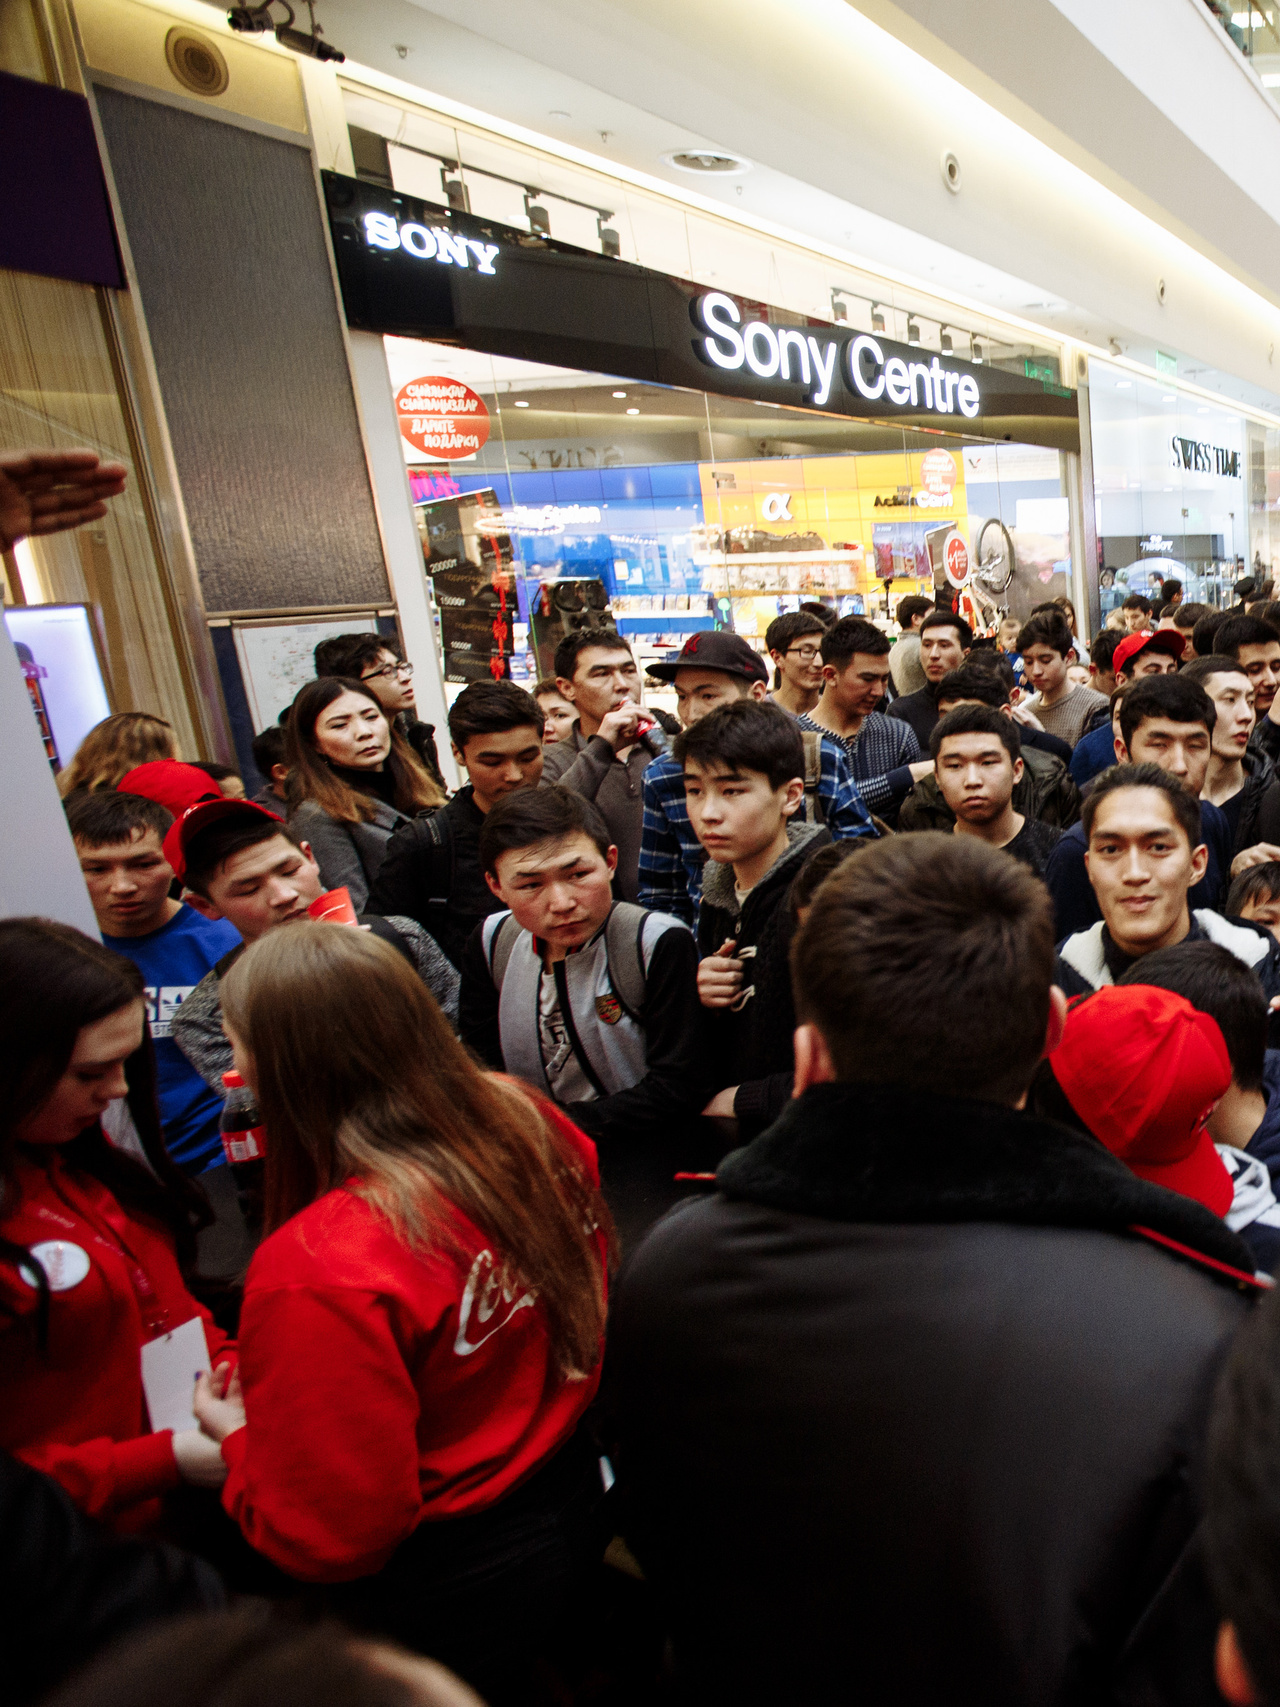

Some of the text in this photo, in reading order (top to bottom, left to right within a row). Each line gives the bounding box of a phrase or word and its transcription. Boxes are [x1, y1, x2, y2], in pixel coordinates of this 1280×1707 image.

[363, 211, 500, 276] SONY
[696, 292, 838, 405] Sony
[847, 336, 980, 418] Centre
[411, 418, 456, 434] ДАРИТЕ
[424, 433, 479, 449] ПОДАРКИ
[1171, 435, 1212, 473] SWISS
